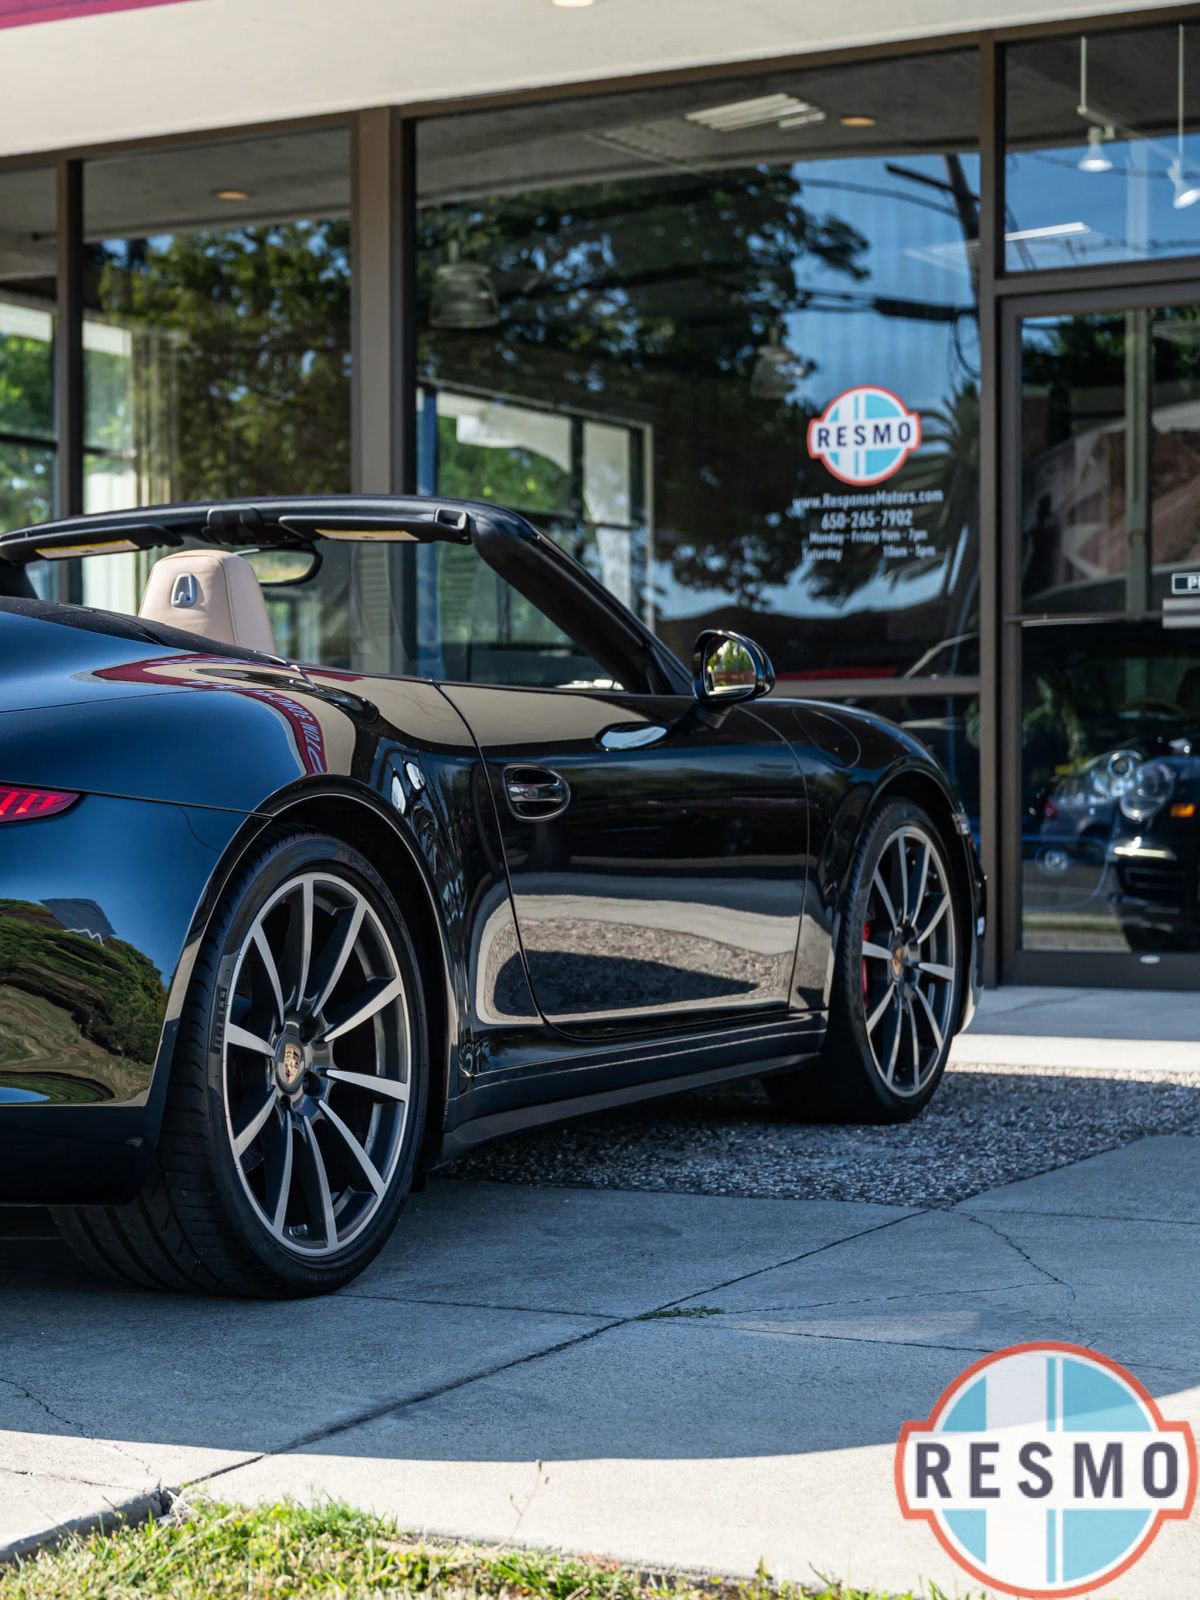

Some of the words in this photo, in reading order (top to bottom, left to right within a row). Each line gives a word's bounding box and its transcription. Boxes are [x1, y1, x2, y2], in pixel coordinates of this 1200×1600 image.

[817, 422, 911, 447] RESMO
[792, 489, 944, 510] www.ResponseMotors.com
[821, 508, 913, 530] 650-265-7902
[809, 531, 845, 546] Monday
[851, 530, 880, 545] Friday
[802, 547, 843, 562] Saturday
